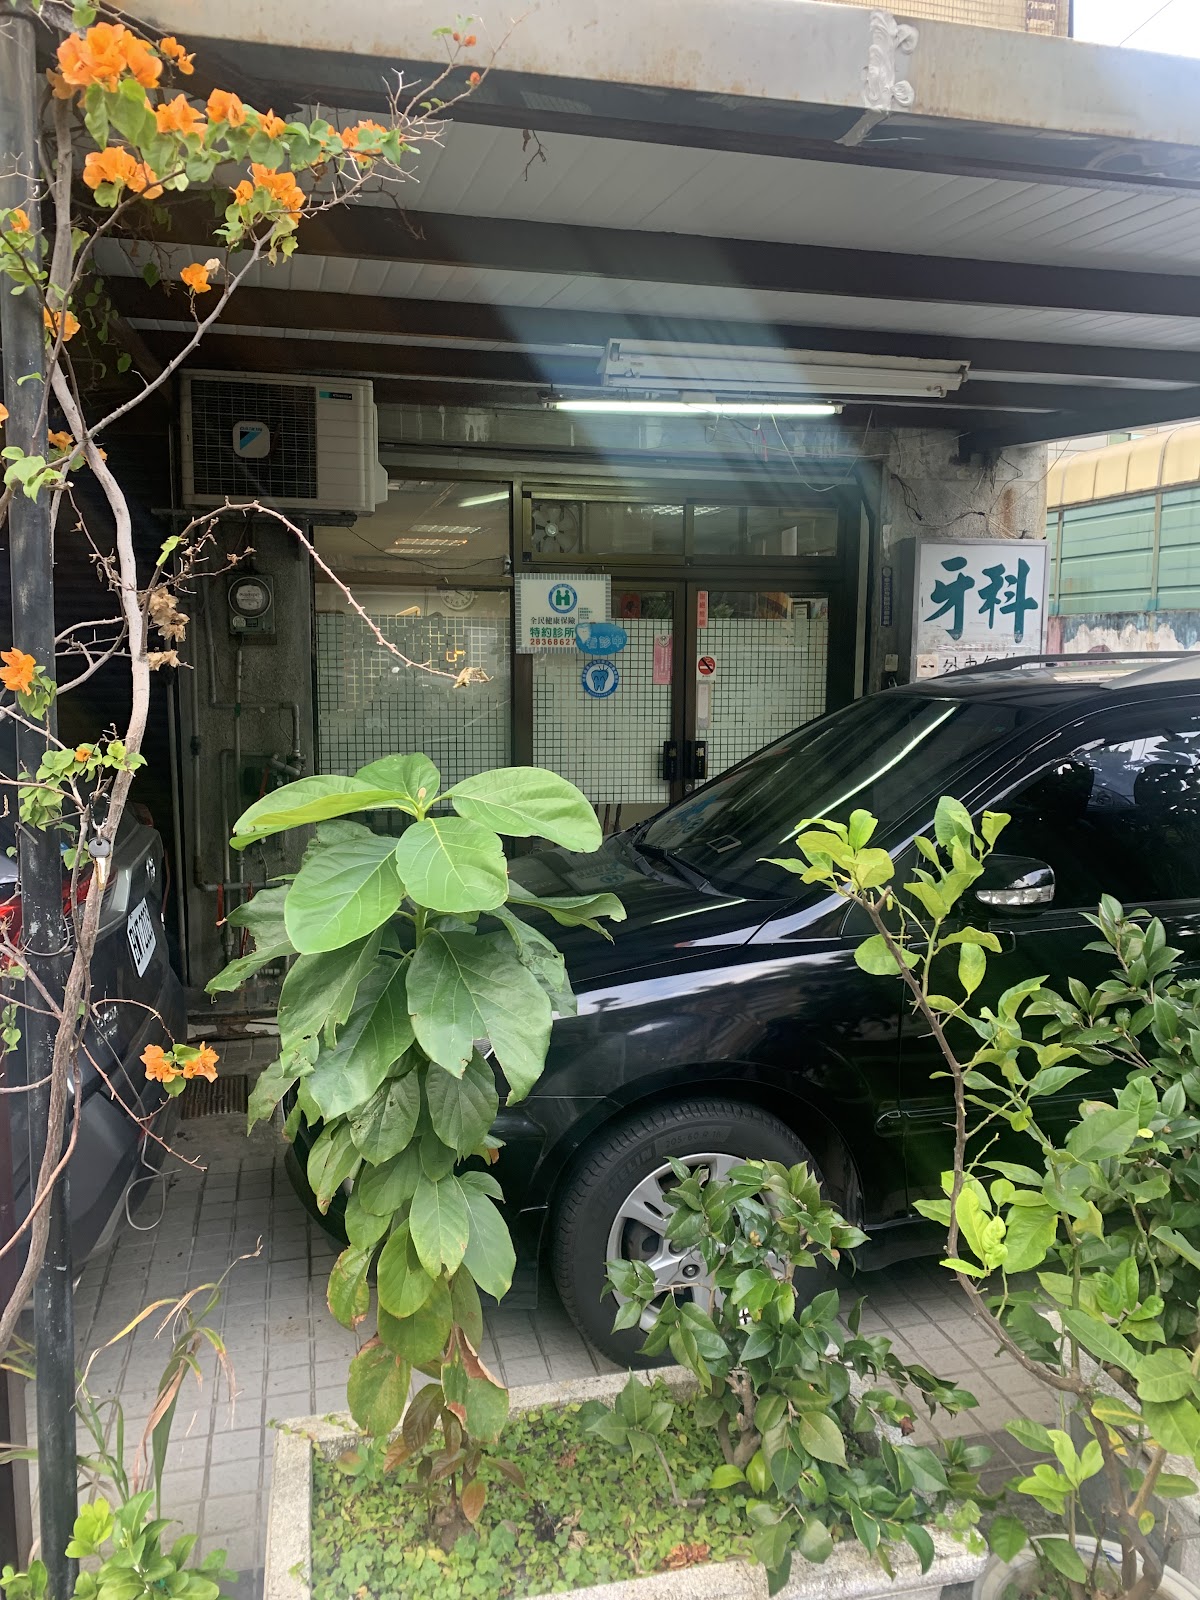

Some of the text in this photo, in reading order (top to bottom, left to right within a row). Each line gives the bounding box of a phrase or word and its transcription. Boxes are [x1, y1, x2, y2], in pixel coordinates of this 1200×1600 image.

[922, 556, 1039, 644] 牙科
[530, 616, 576, 625] 全民健康保險
[529, 626, 576, 638] 特約診所
[530, 638, 576, 646] 28368627
